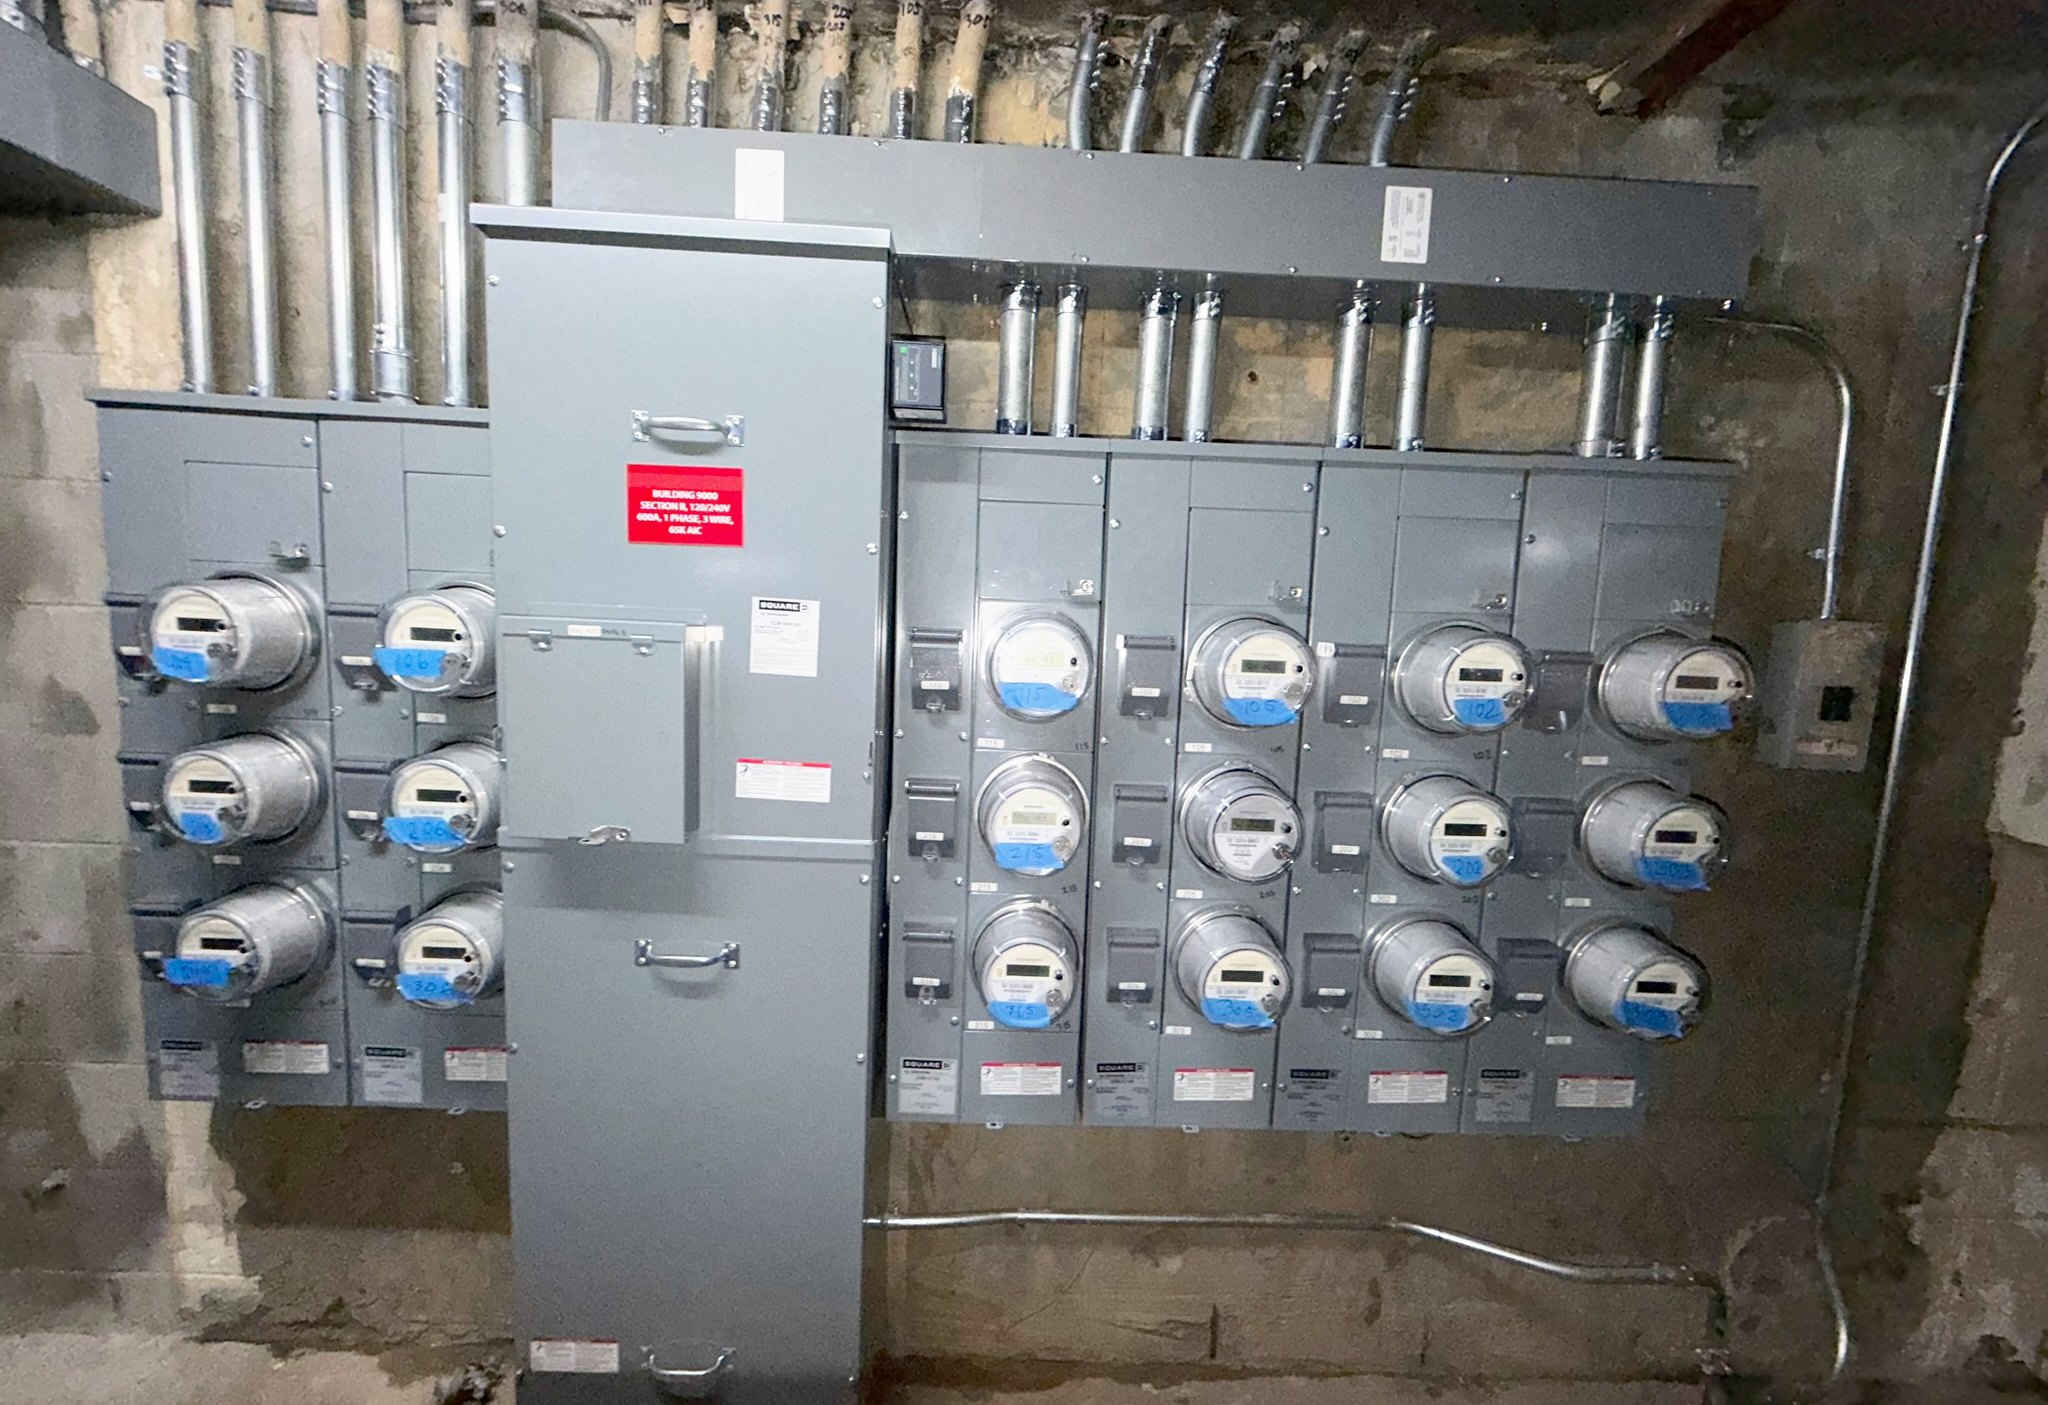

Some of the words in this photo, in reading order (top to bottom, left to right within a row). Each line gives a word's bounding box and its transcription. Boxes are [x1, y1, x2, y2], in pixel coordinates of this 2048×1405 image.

[652, 489, 696, 499] BUILDING
[696, 491, 719, 500] 9000
[640, 501, 679, 511] SECTION
[680, 502, 688, 512] B,
[689, 503, 731, 513] 120/240V
[636, 512, 662, 522] 600A,
[663, 513, 669, 522] 1
[670, 513, 701, 524] PHASE,
[702, 514, 709, 524] 3
[709, 515, 735, 525] WIRE,
[668, 525, 686, 535] 65K
[687, 526, 703, 535] AIC
[760, 601, 799, 611] SQUARE
[1469, 699, 1501, 719] 102
[1074, 741, 1089, 751] 115
[1008, 846, 1045, 861] 215
[904, 1060, 942, 1069] SQUARE
[1098, 1063, 1135, 1072] SQUARE
